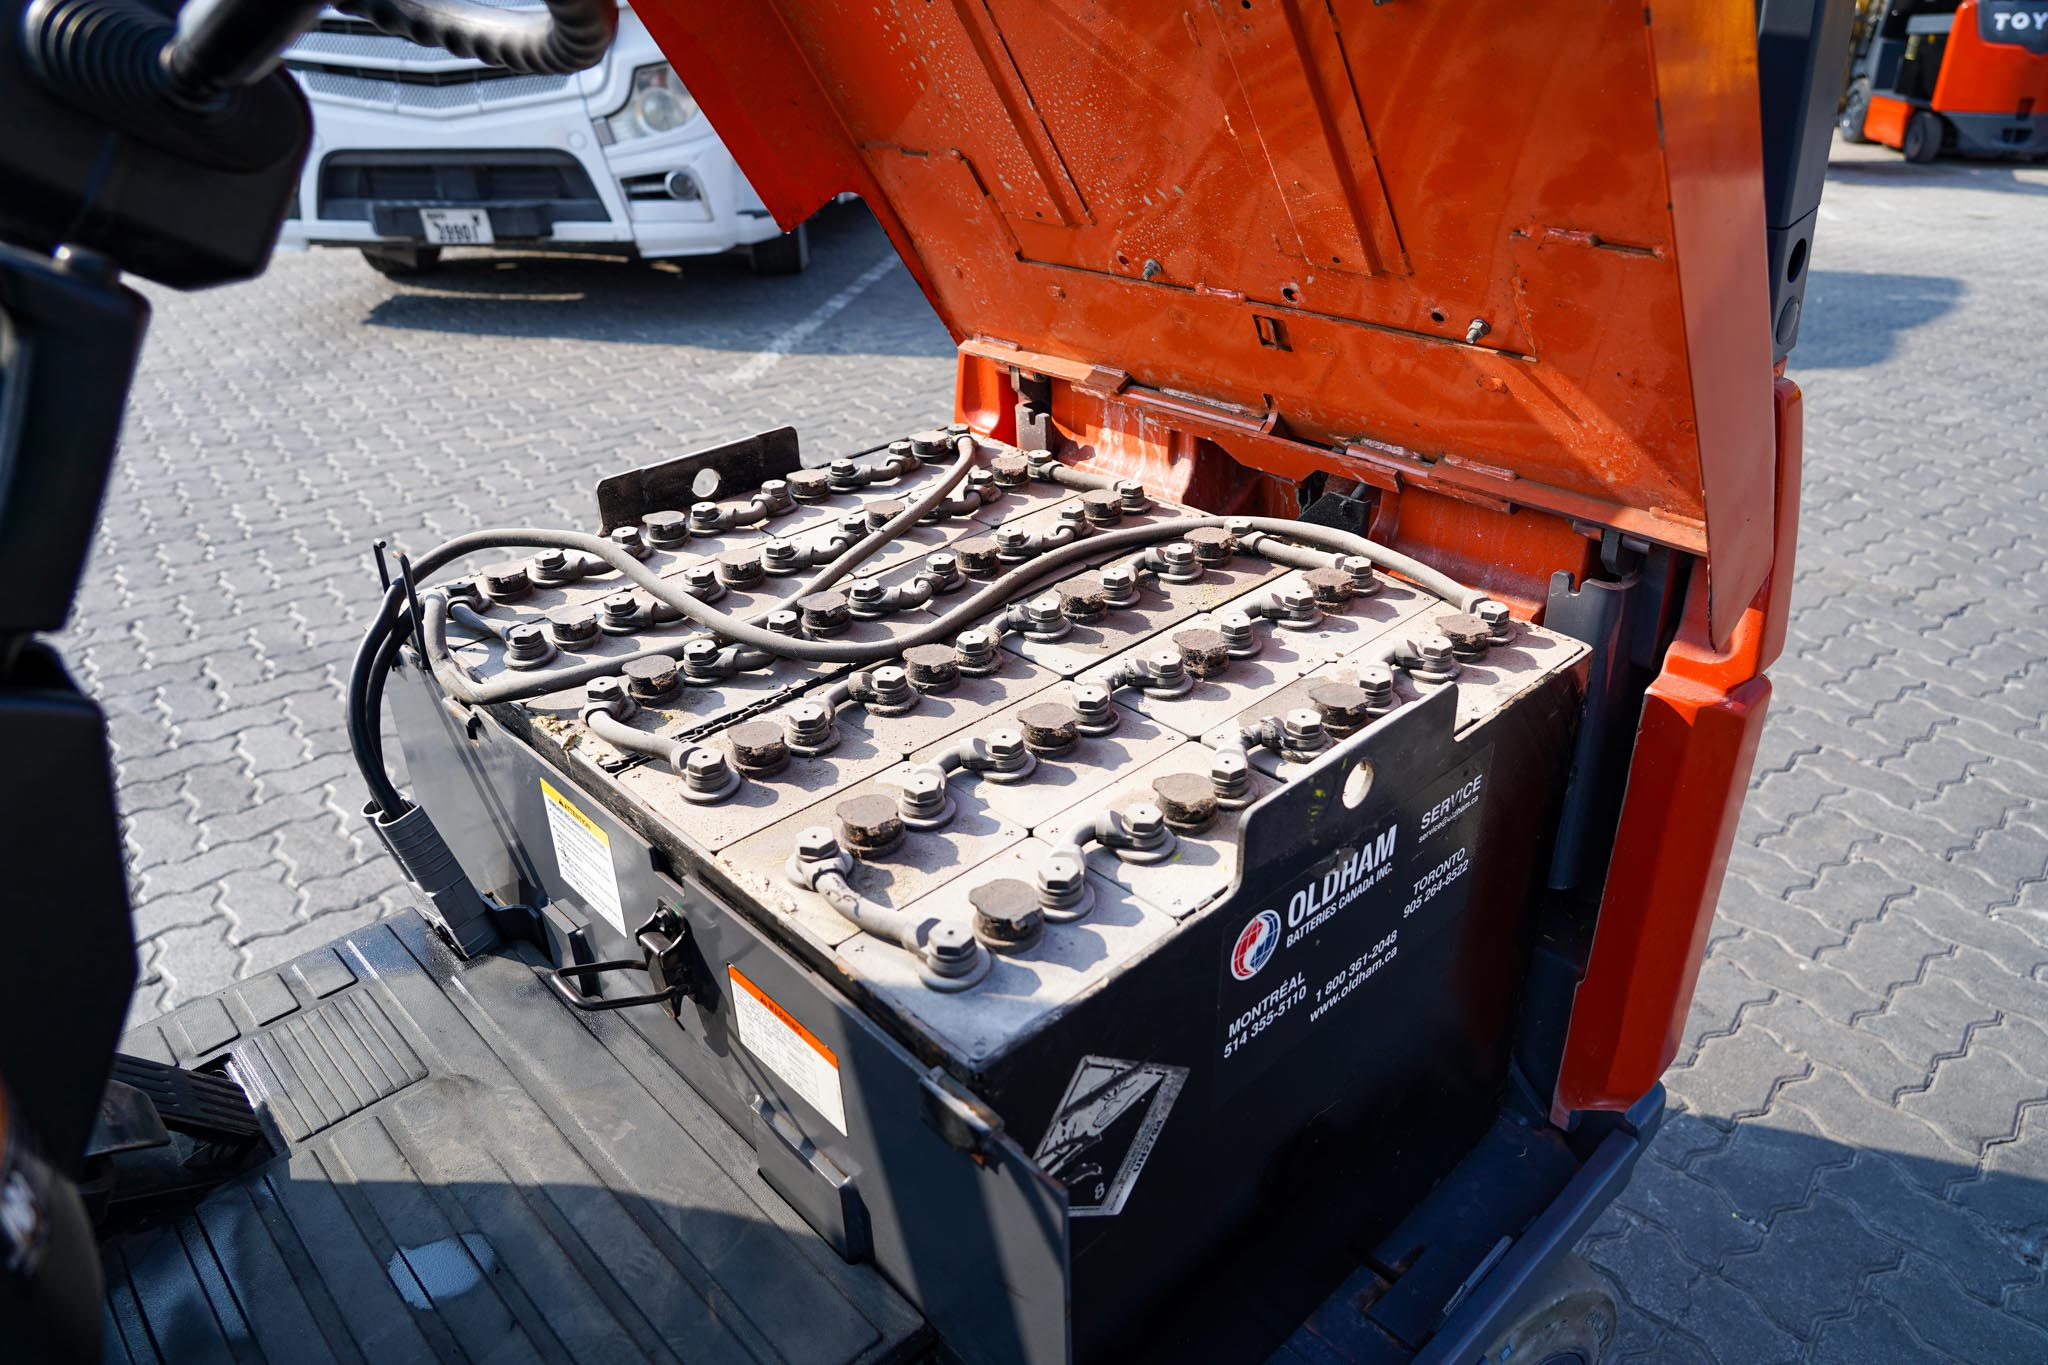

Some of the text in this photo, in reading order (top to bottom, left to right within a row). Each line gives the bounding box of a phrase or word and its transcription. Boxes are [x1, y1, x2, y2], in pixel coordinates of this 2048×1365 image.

[1993, 12, 2048, 31] TOY
[564, 803, 592, 831] ATTENTION
[1421, 774, 1483, 830] SERVICE
[1287, 823, 1398, 929] OLDHAM
[1403, 859, 1469, 918] 905 264-8522
[1413, 847, 1466, 895] TORONTO
[1286, 862, 1393, 948] BATTERIES CANADA INC.
[1309, 946, 1398, 1022] www.oldham.ca
[1316, 929, 1398, 1002] 1 800 361-2048
[1223, 985, 1307, 1059] 514 355-5110
[1228, 971, 1306, 1039] MONTRÉAL
[1133, 1119, 1164, 1173] UN2794
[1094, 1182, 1106, 1201] 8
